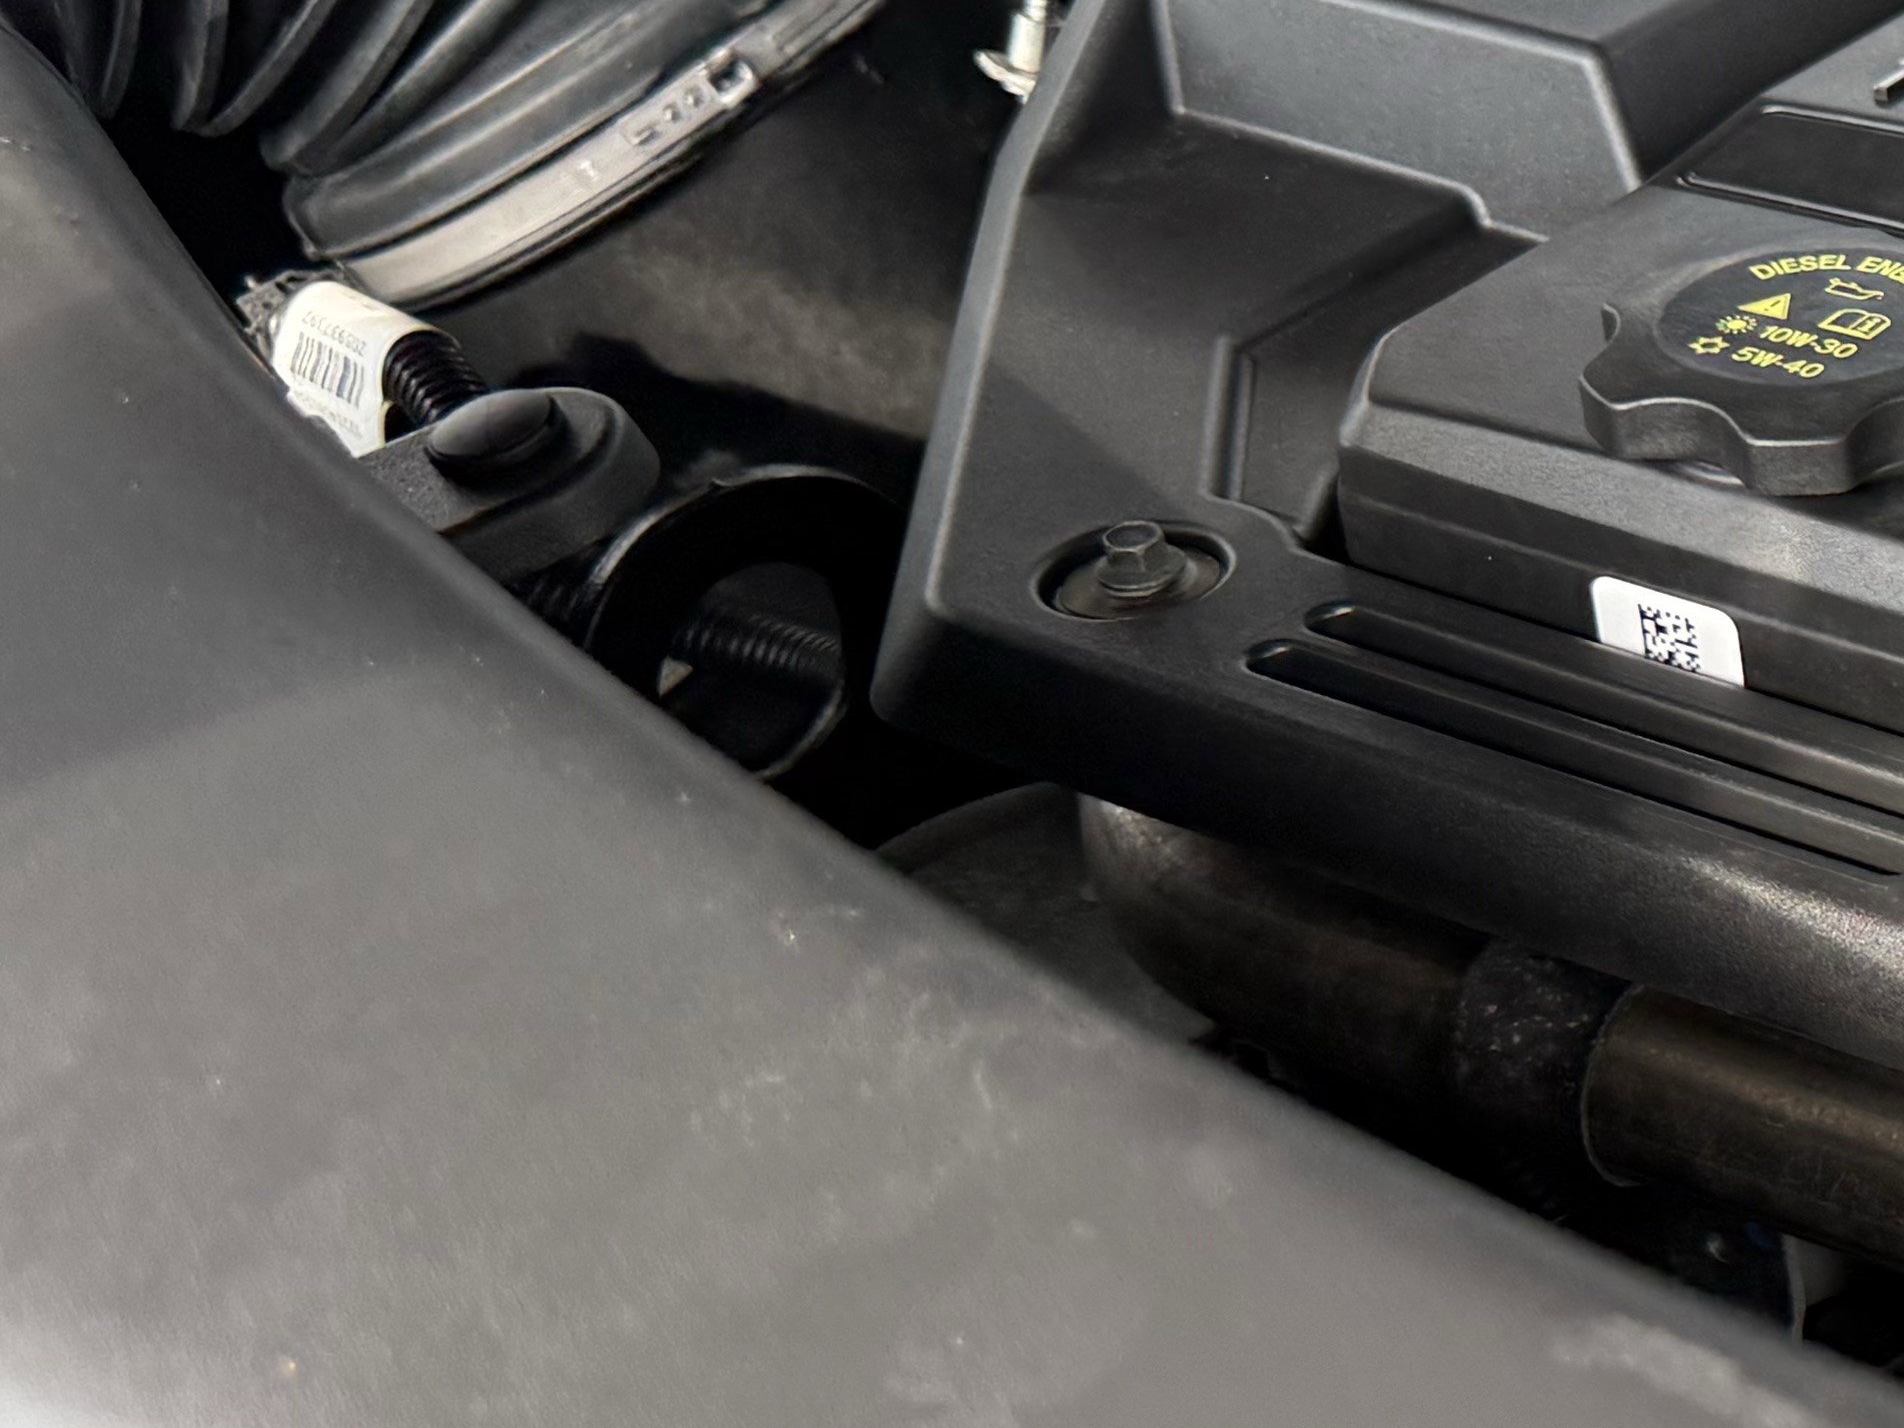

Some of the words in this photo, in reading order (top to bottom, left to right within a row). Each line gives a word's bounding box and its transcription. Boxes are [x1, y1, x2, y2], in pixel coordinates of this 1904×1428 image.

[1748, 253, 1852, 281] DIESEL
[1759, 324, 1860, 360] 10W-30
[1730, 345, 1826, 379] 5W-40
